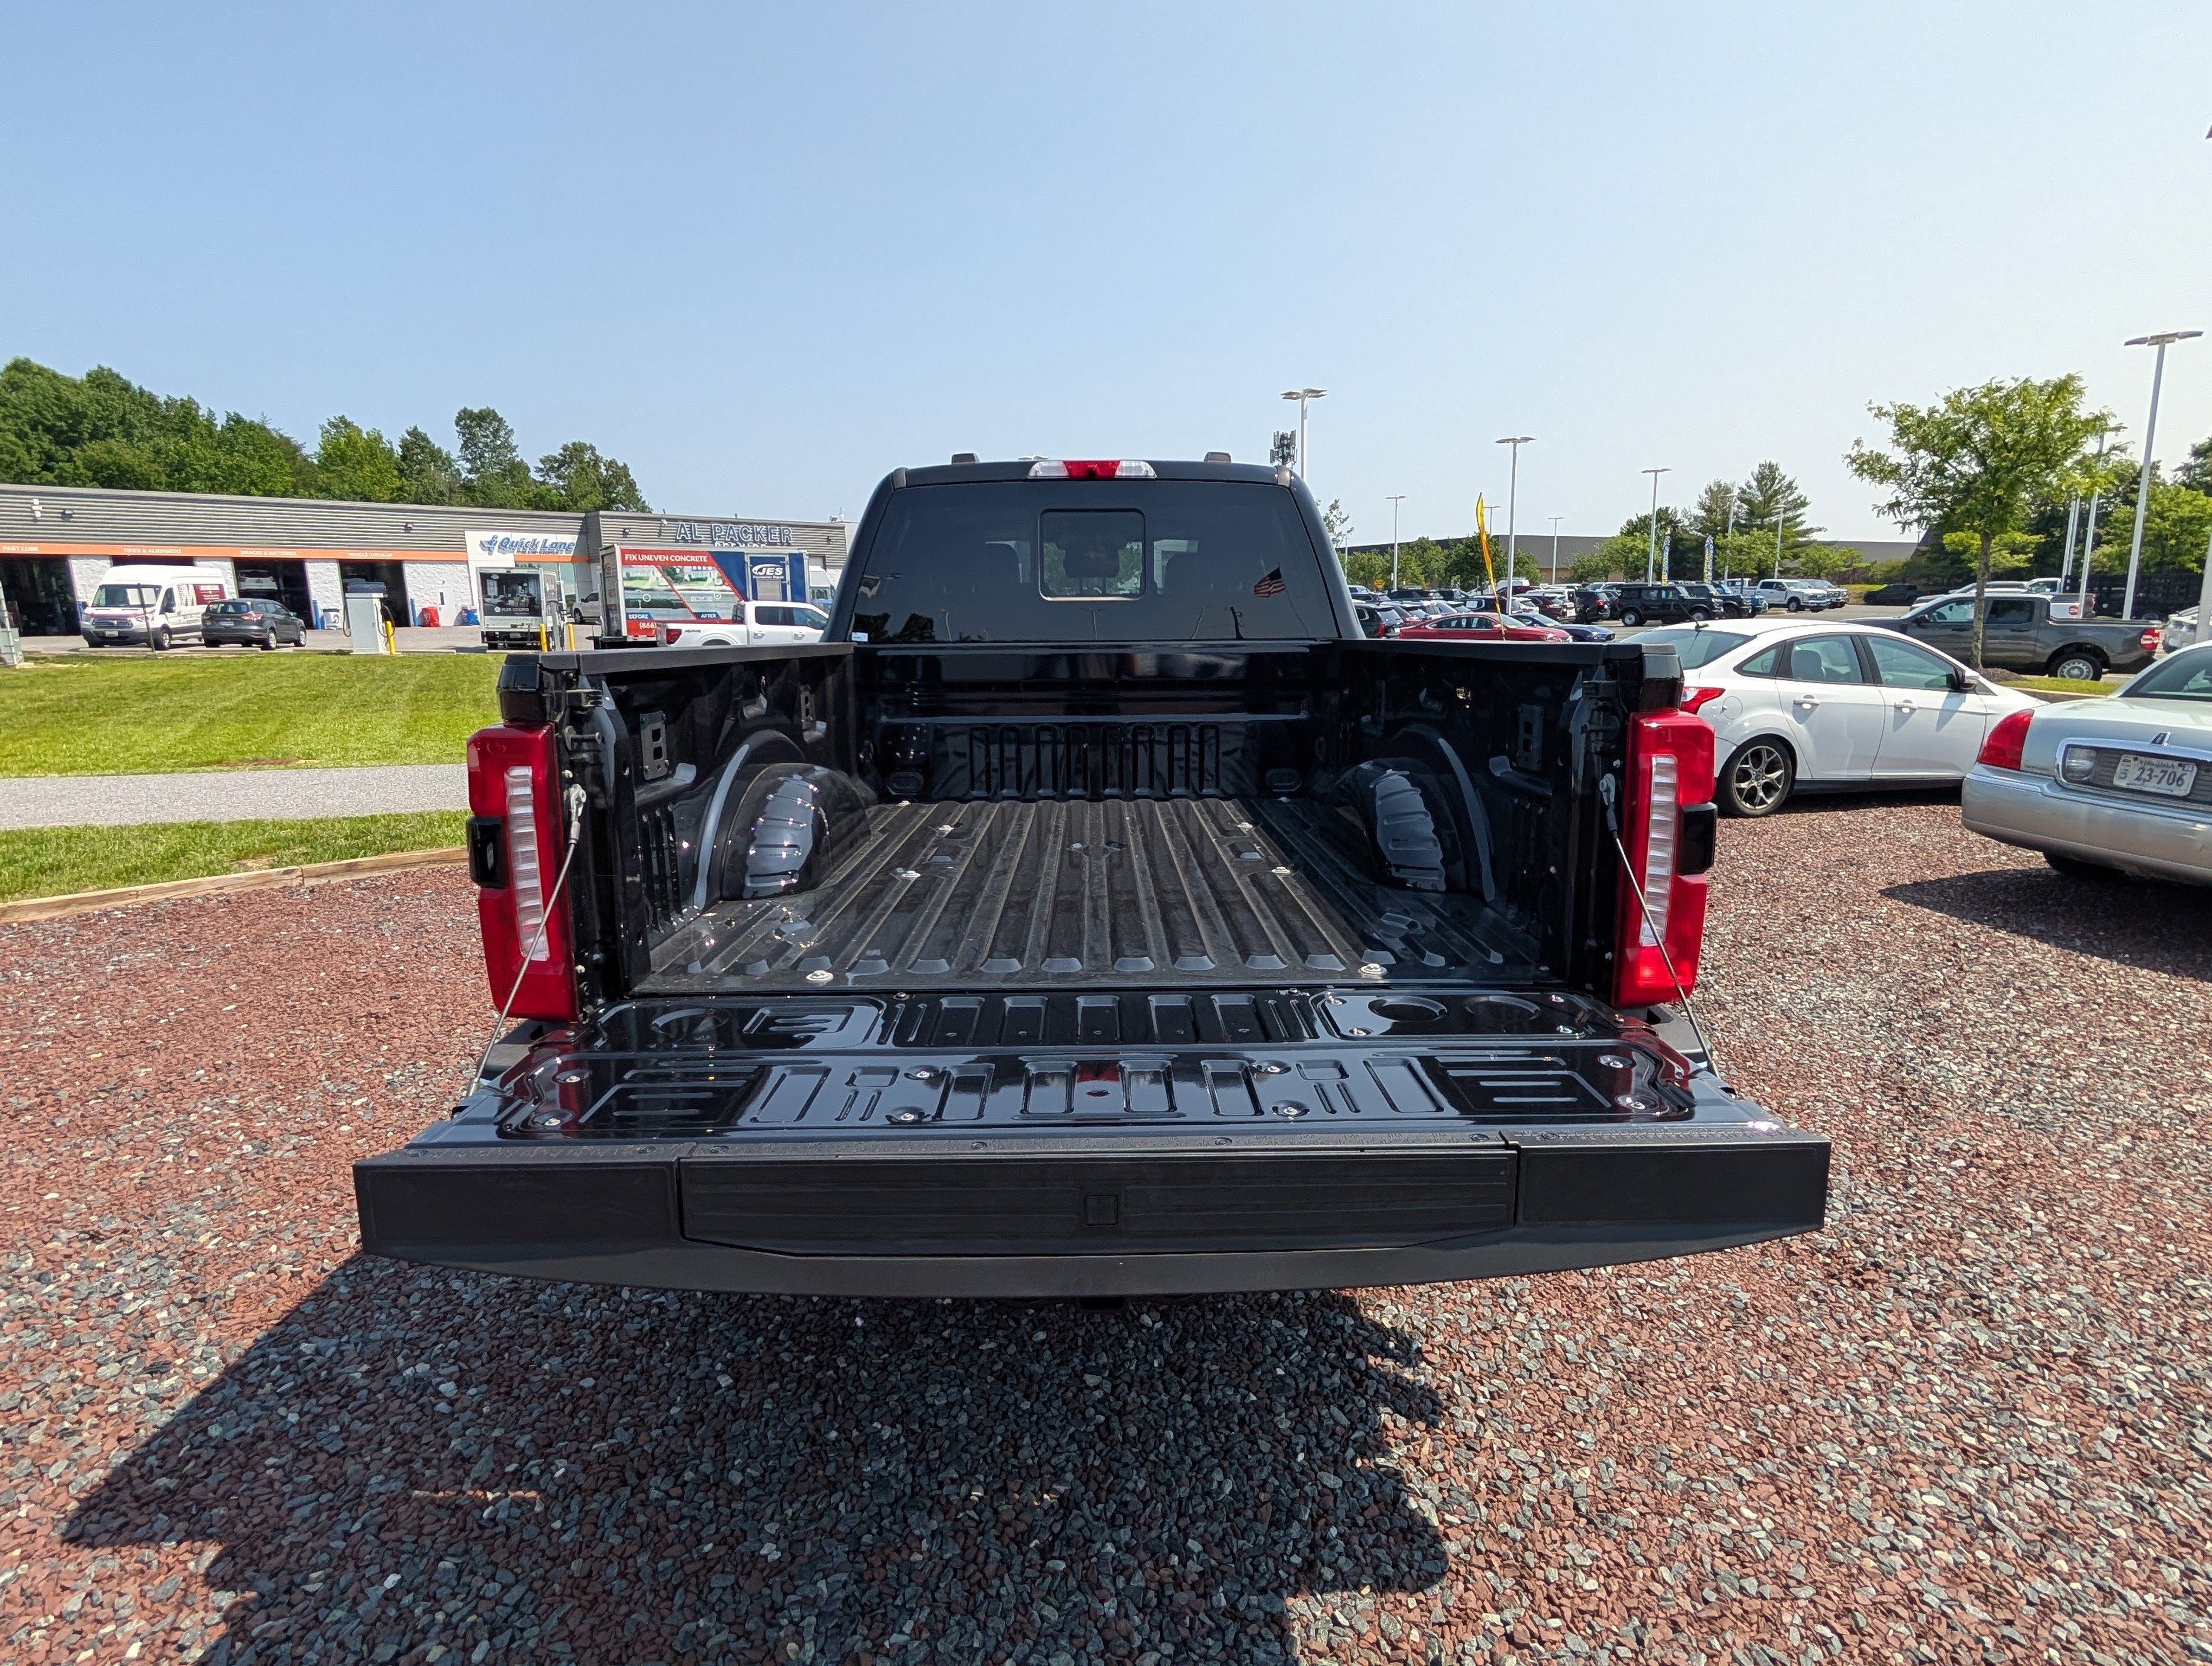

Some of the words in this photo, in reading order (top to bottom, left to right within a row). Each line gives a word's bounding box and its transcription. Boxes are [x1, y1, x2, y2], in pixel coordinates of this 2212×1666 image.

[677, 523, 704, 540] AL
[712, 523, 794, 542] PACKER
[499, 537, 540, 550] Quick
[542, 539, 575, 550] Lane
[757, 567, 783, 575] JES
[2134, 766, 2188, 787] 23-706
